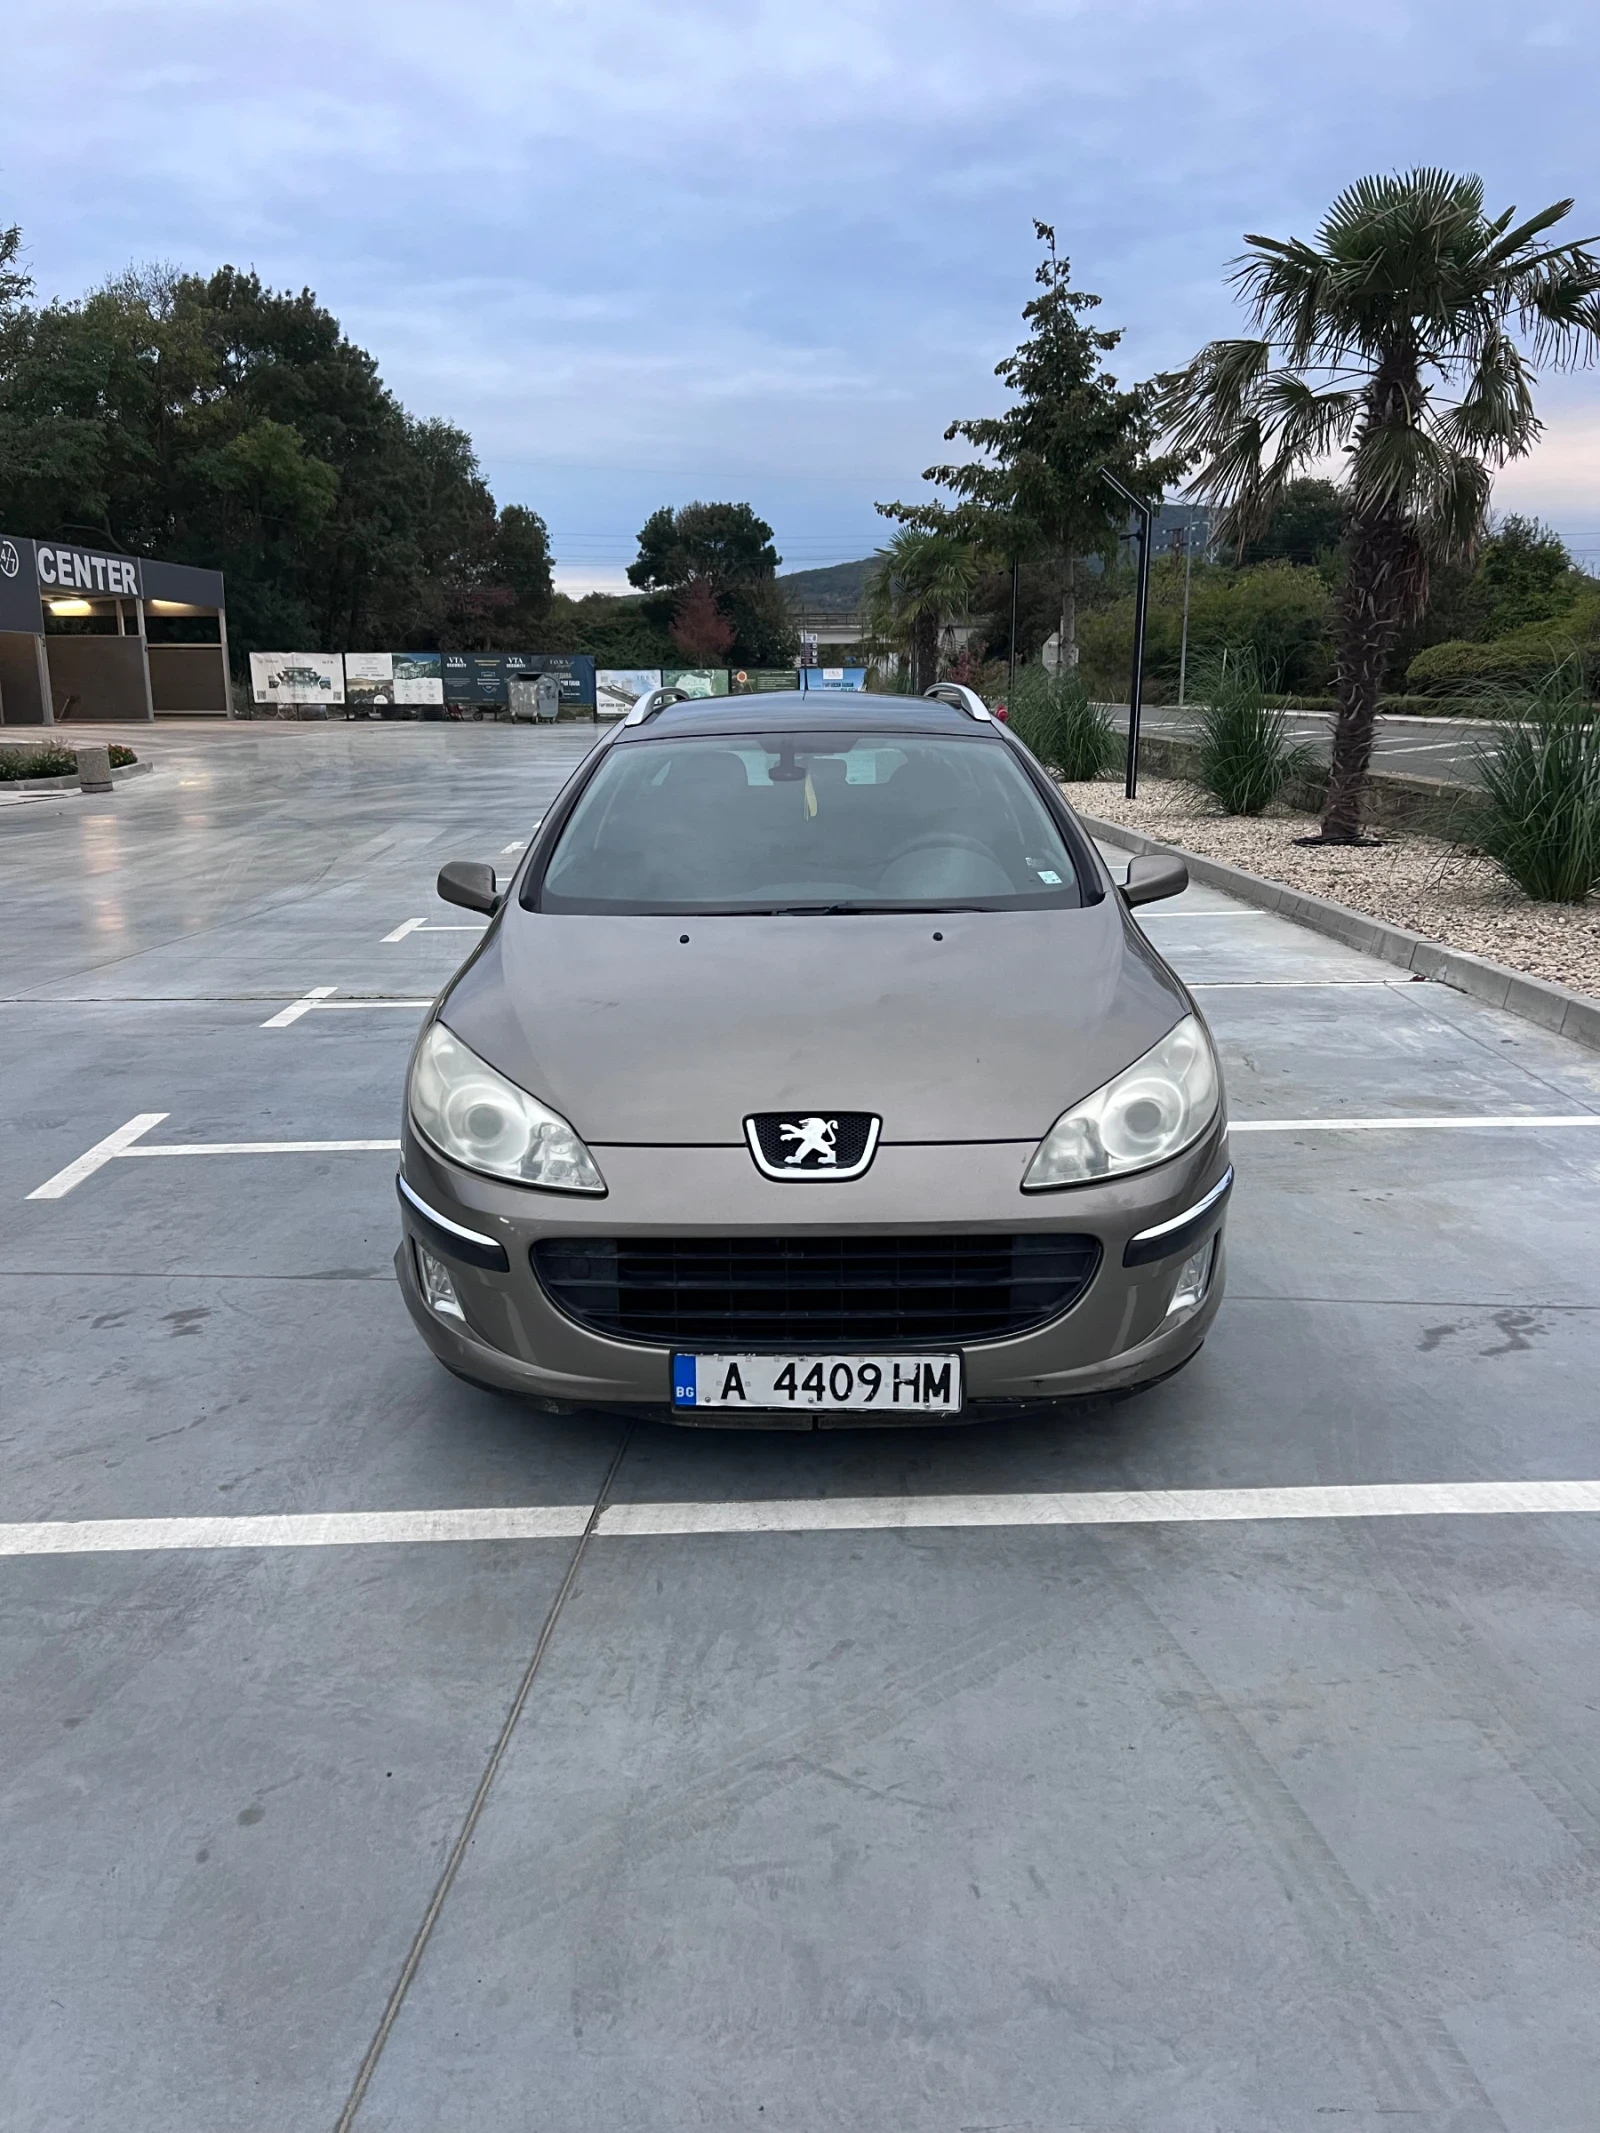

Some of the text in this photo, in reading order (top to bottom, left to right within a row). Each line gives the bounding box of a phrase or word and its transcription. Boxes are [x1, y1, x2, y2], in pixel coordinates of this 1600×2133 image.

[0, 548, 15, 571] 4/7
[37, 547, 139, 595] CENTER
[676, 1386, 694, 1398] BG
[720, 1362, 746, 1400] A
